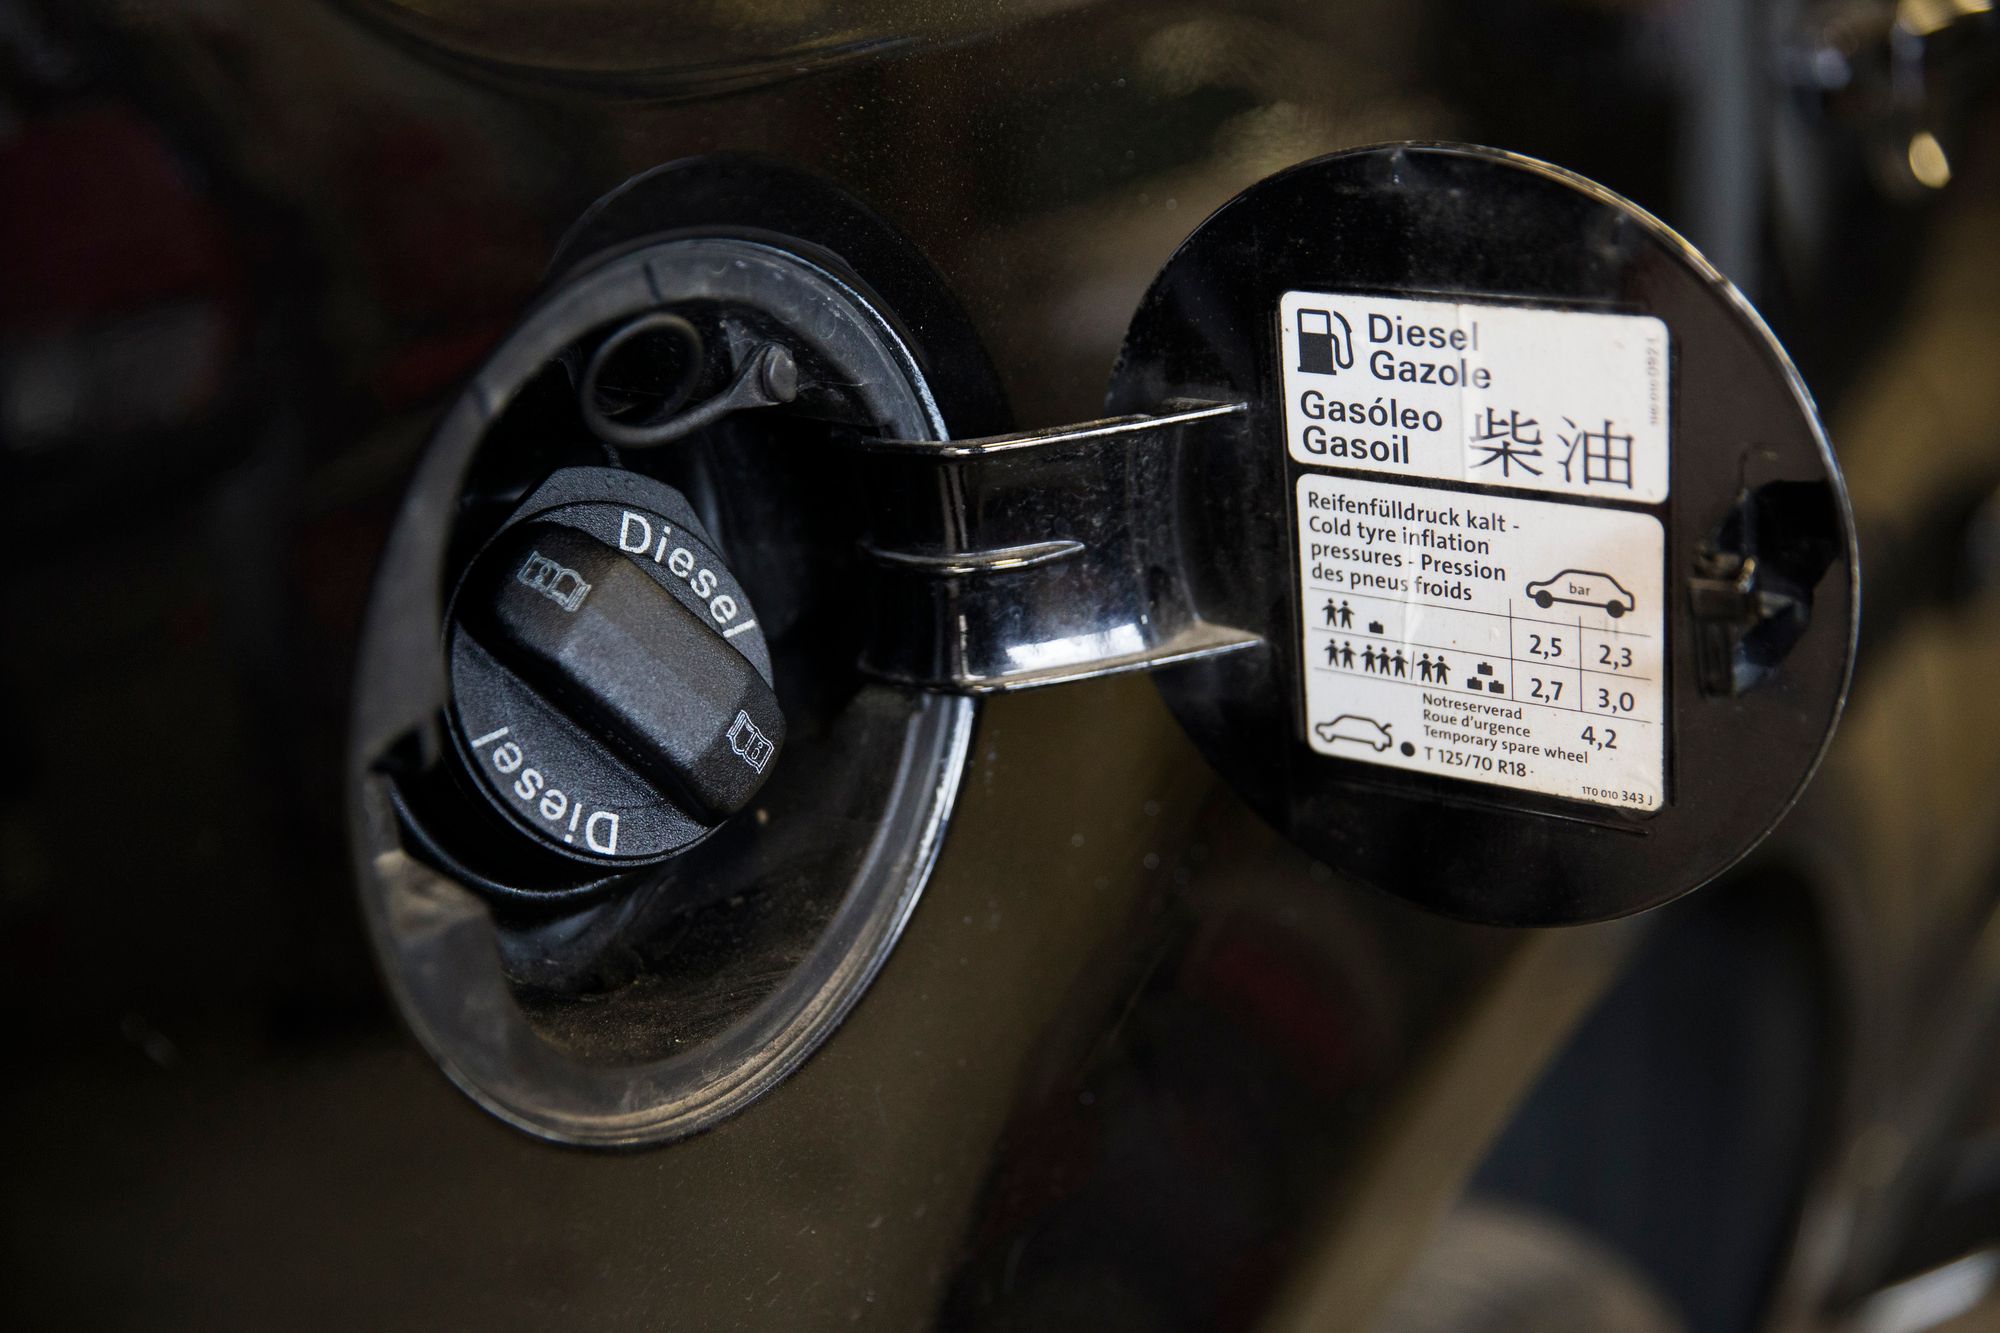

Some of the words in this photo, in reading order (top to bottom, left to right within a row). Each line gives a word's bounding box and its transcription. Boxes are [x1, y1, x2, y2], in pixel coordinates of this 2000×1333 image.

[1368, 313, 1479, 352] Diesel
[1369, 350, 1492, 390] Gazole
[1300, 390, 1442, 432] Gasóleo
[1302, 425, 1410, 464] Gasoil
[1468, 406, 1634, 490] 柴油
[1308, 491, 1461, 527] Reifenfülldruck
[1467, 510, 1506, 532] kalt
[1309, 516, 1351, 537] Cold
[1357, 522, 1397, 545] tyre
[1402, 526, 1489, 555] inflation
[619, 510, 757, 639] Diesel
[1311, 543, 1402, 567] pressures
[1421, 553, 1506, 582] Pression
[1311, 562, 1344, 583] des
[1350, 571, 1409, 592] pneus
[1415, 575, 1472, 601] froids
[1568, 582, 1591, 597] bar
[1529, 634, 1563, 660] 2,5
[1599, 644, 1633, 671] 2,3
[1423, 692, 1522, 720] Notreserverad
[1530, 678, 1563, 702] 2,7
[1599, 688, 1635, 713] 3,0
[1423, 709, 1457, 725] Roue
[1424, 724, 1498, 751] Temporary
[1501, 741, 1540, 756] spare
[1544, 747, 1588, 764] wheel
[1581, 726, 1617, 751] 4,2
[1424, 747, 1433, 761] T
[1438, 749, 1492, 771] 125/70
[1498, 760, 1527, 777] R18
[470, 726, 620, 855] Diesel
[1582, 786, 1598, 796] 1T0
[1601, 789, 1618, 799] 010
[1622, 791, 1644, 804] 343
